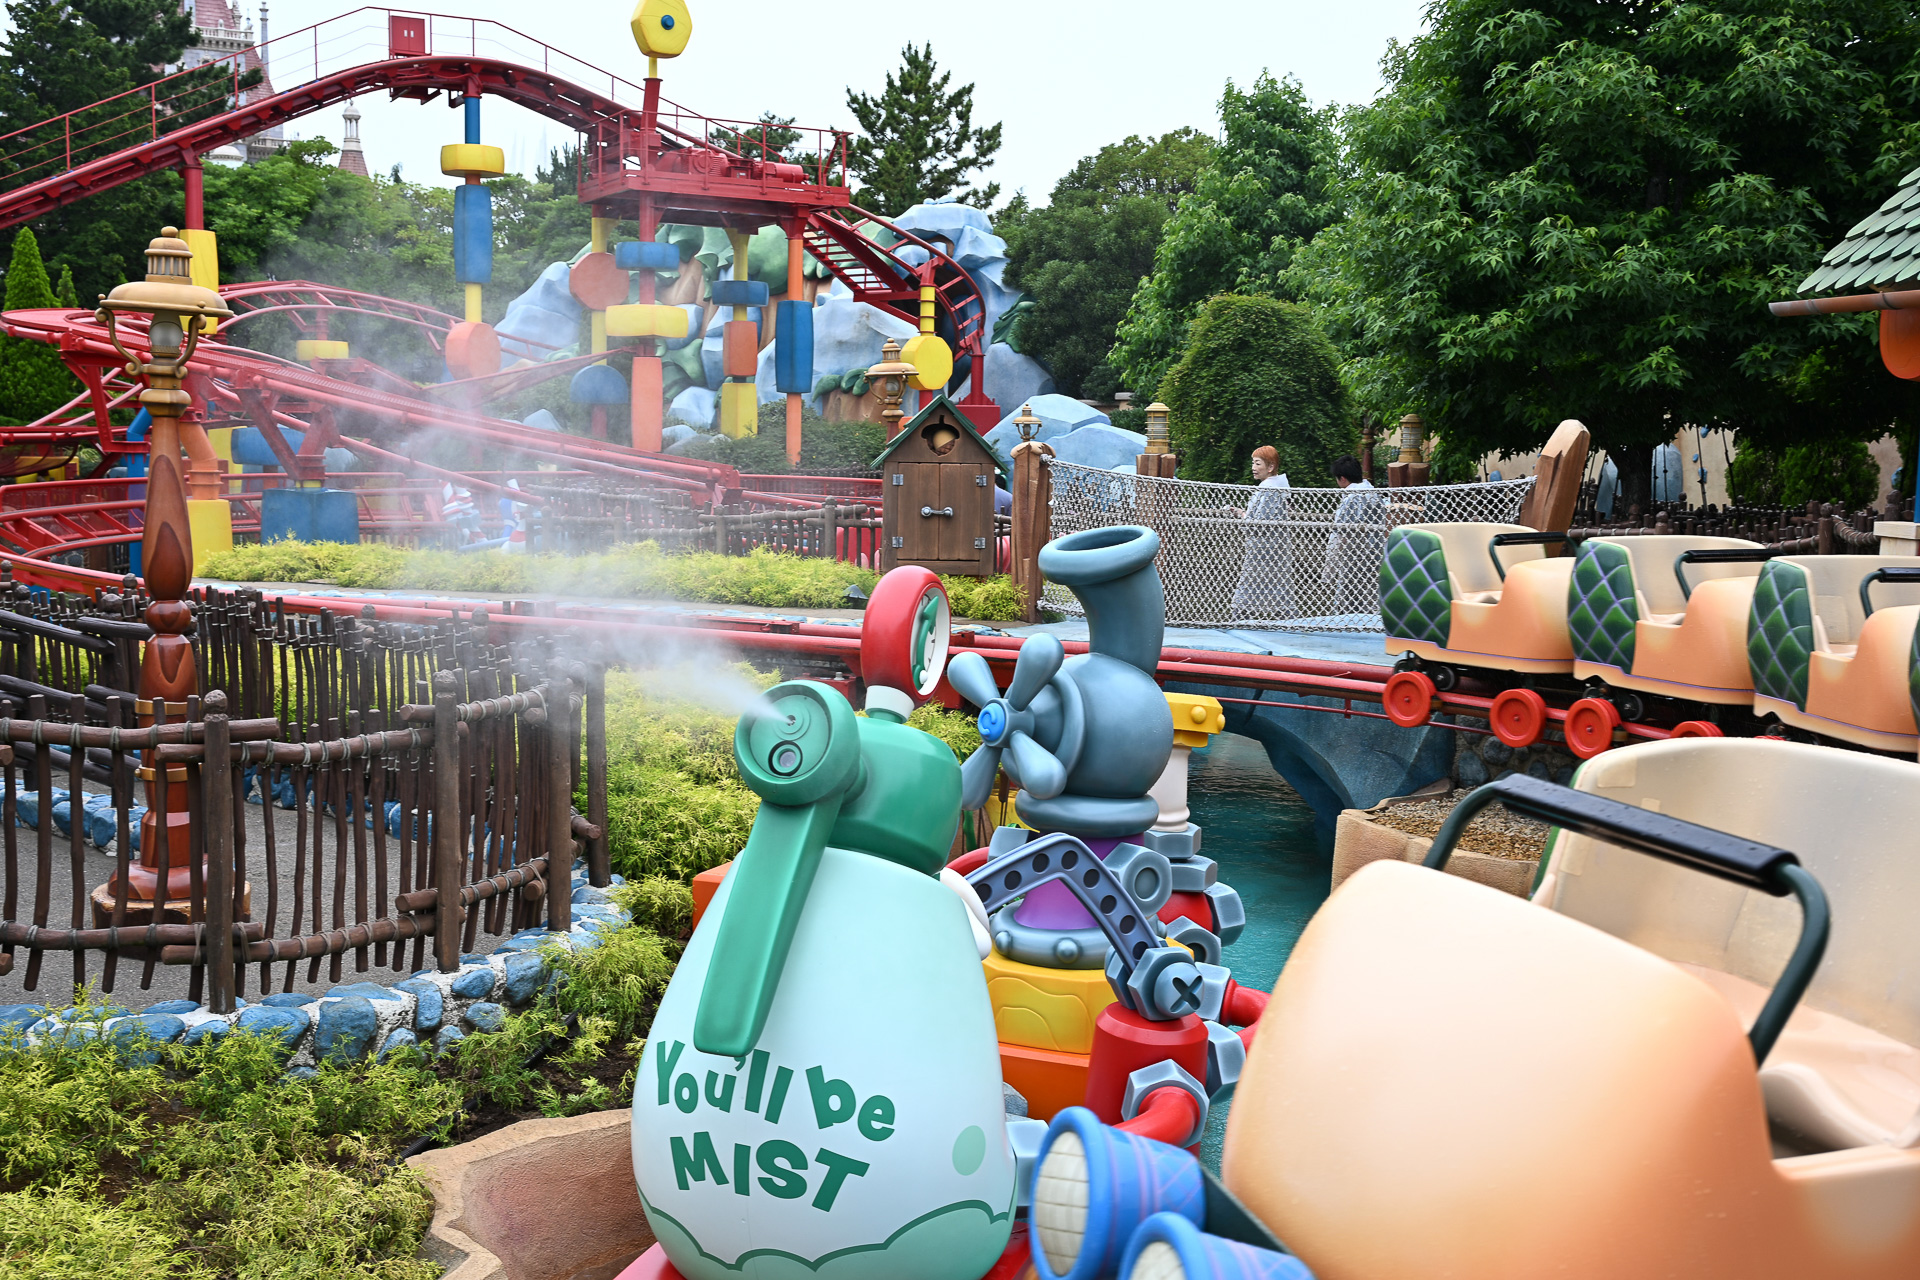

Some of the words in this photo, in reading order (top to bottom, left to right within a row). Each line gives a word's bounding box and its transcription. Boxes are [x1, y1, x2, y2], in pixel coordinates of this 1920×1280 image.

[657, 1040, 794, 1124] You'll
[805, 1065, 896, 1141] be
[670, 1131, 870, 1212] MIST
